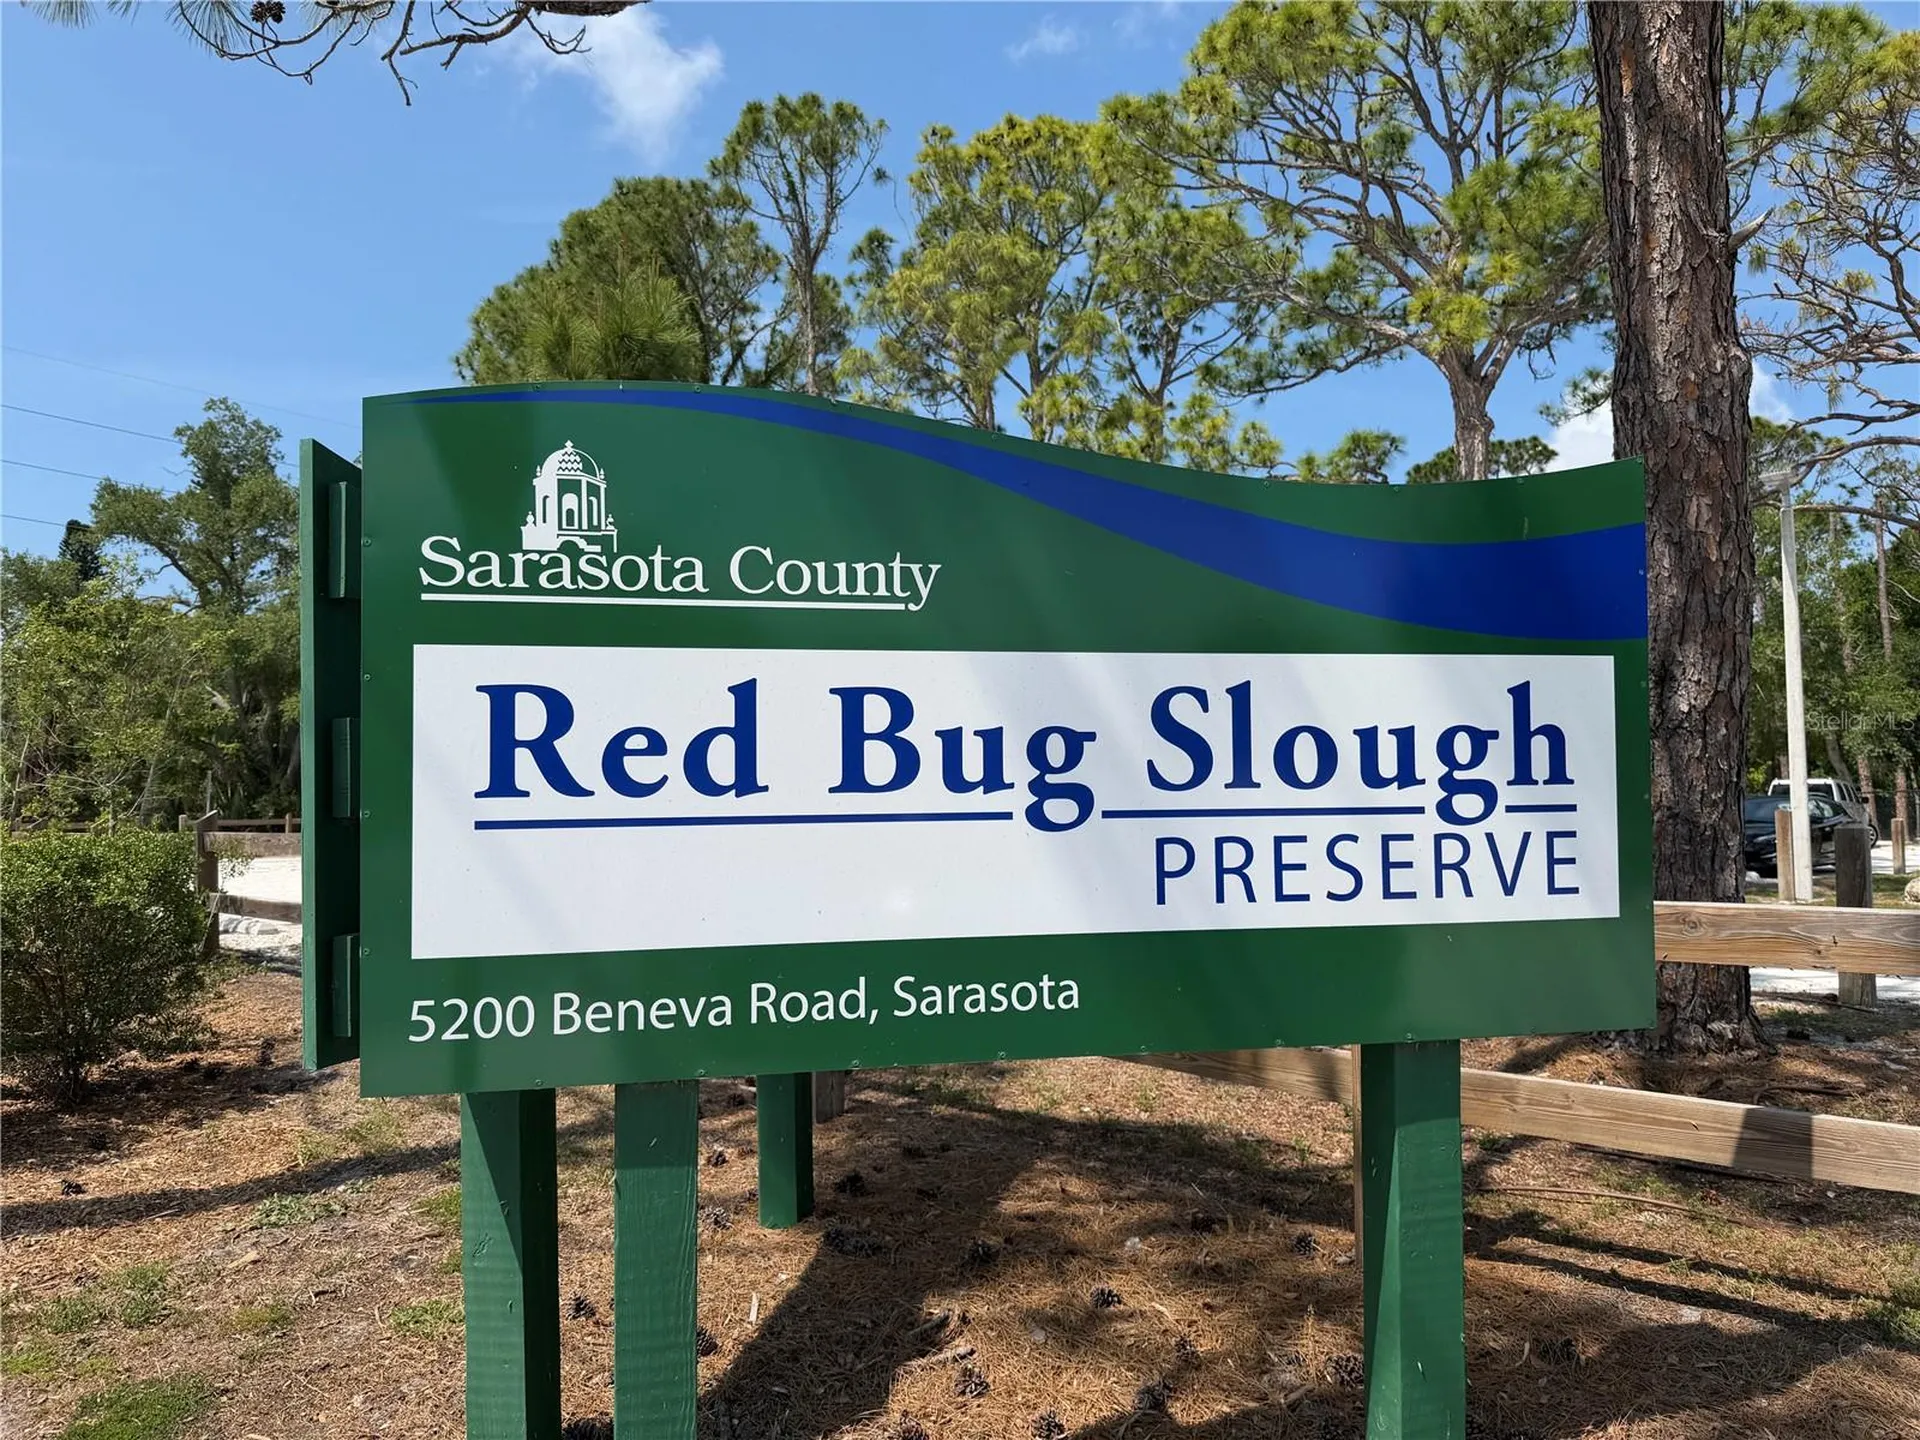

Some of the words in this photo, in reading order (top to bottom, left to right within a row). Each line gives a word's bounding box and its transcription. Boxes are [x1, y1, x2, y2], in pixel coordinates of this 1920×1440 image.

[419, 536, 709, 593] Sarasota
[730, 546, 942, 611] County
[474, 678, 769, 799] Red
[828, 686, 1097, 832] Bug
[1146, 680, 1575, 826] Slough
[1155, 830, 1580, 906] PRESERVE
[408, 995, 535, 1042] 5200
[552, 991, 733, 1036] Beneva
[749, 976, 879, 1026] Road,
[893, 972, 1080, 1018] Sarasota
